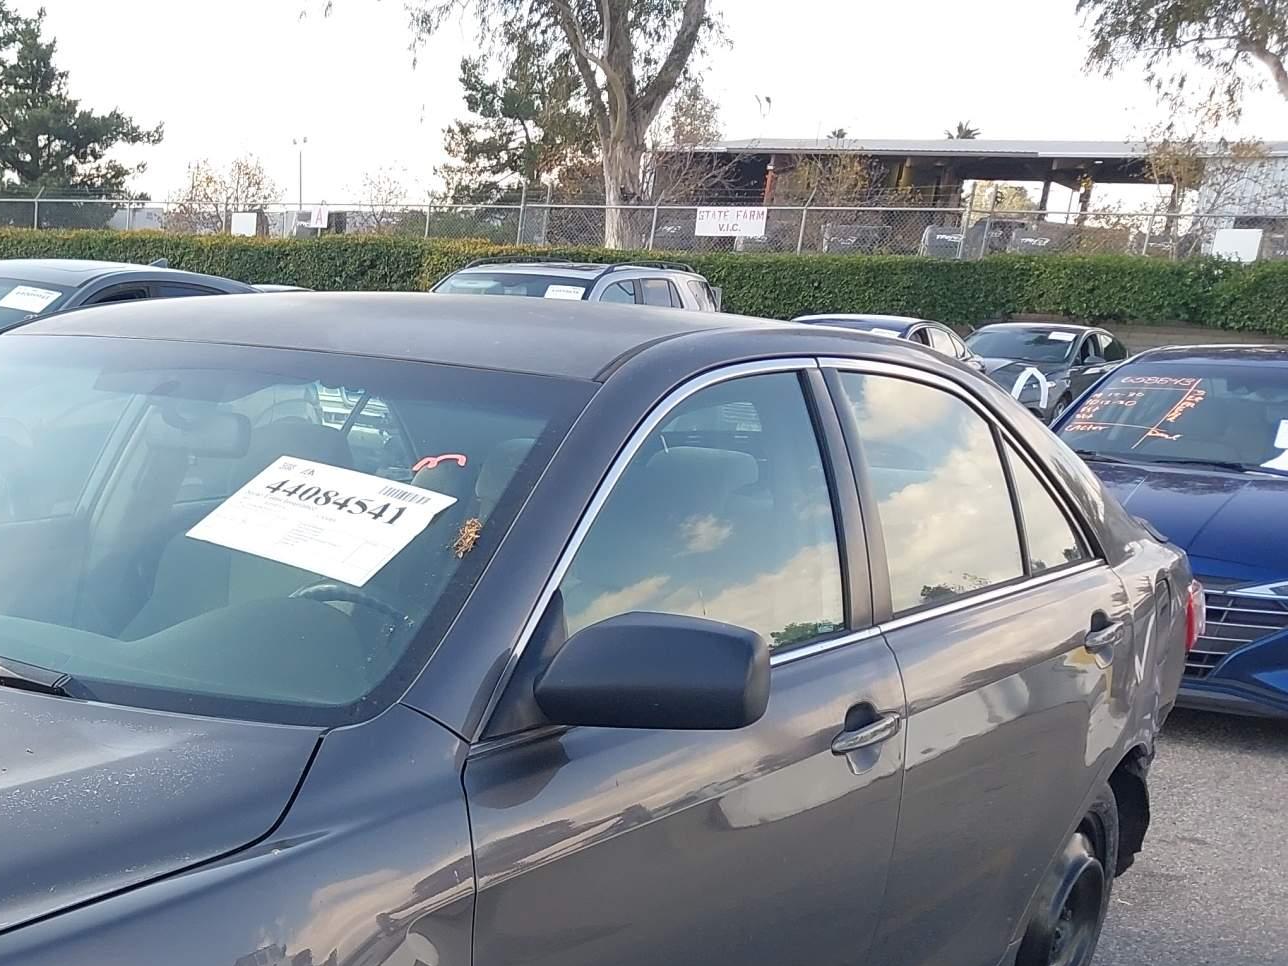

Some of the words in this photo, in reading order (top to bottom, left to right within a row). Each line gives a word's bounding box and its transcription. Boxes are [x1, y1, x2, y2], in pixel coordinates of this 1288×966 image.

[315, 207, 323, 225] A
[698, 210, 730, 221] STATE
[736, 210, 765, 221] FARM
[718, 223, 742, 232] V.I.C.
[265, 479, 408, 525] 44084541
